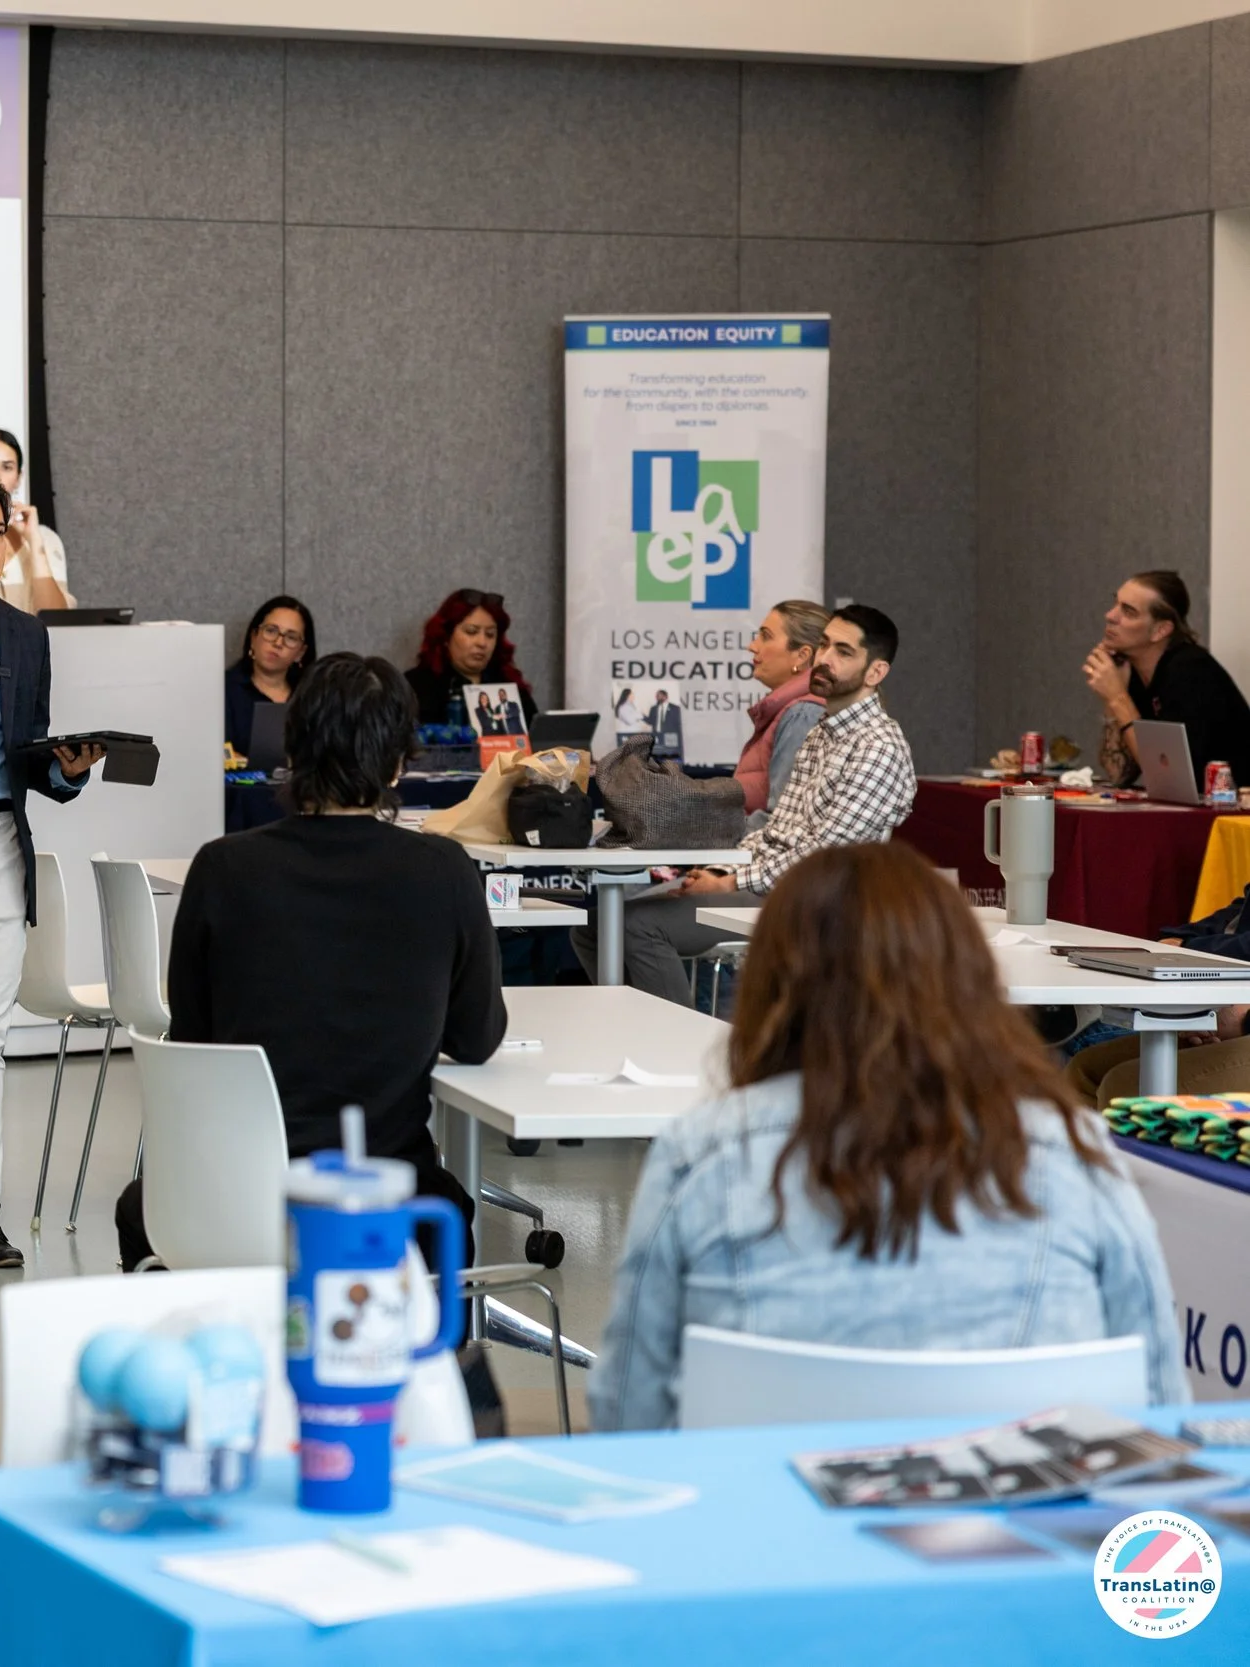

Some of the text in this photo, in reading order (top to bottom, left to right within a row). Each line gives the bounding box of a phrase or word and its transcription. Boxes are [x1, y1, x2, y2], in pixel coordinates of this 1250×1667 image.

[612, 326, 776, 342] EDUCATION EQUITY
[611, 630, 655, 650] LOS
[611, 661, 754, 680] EDUCATIO
